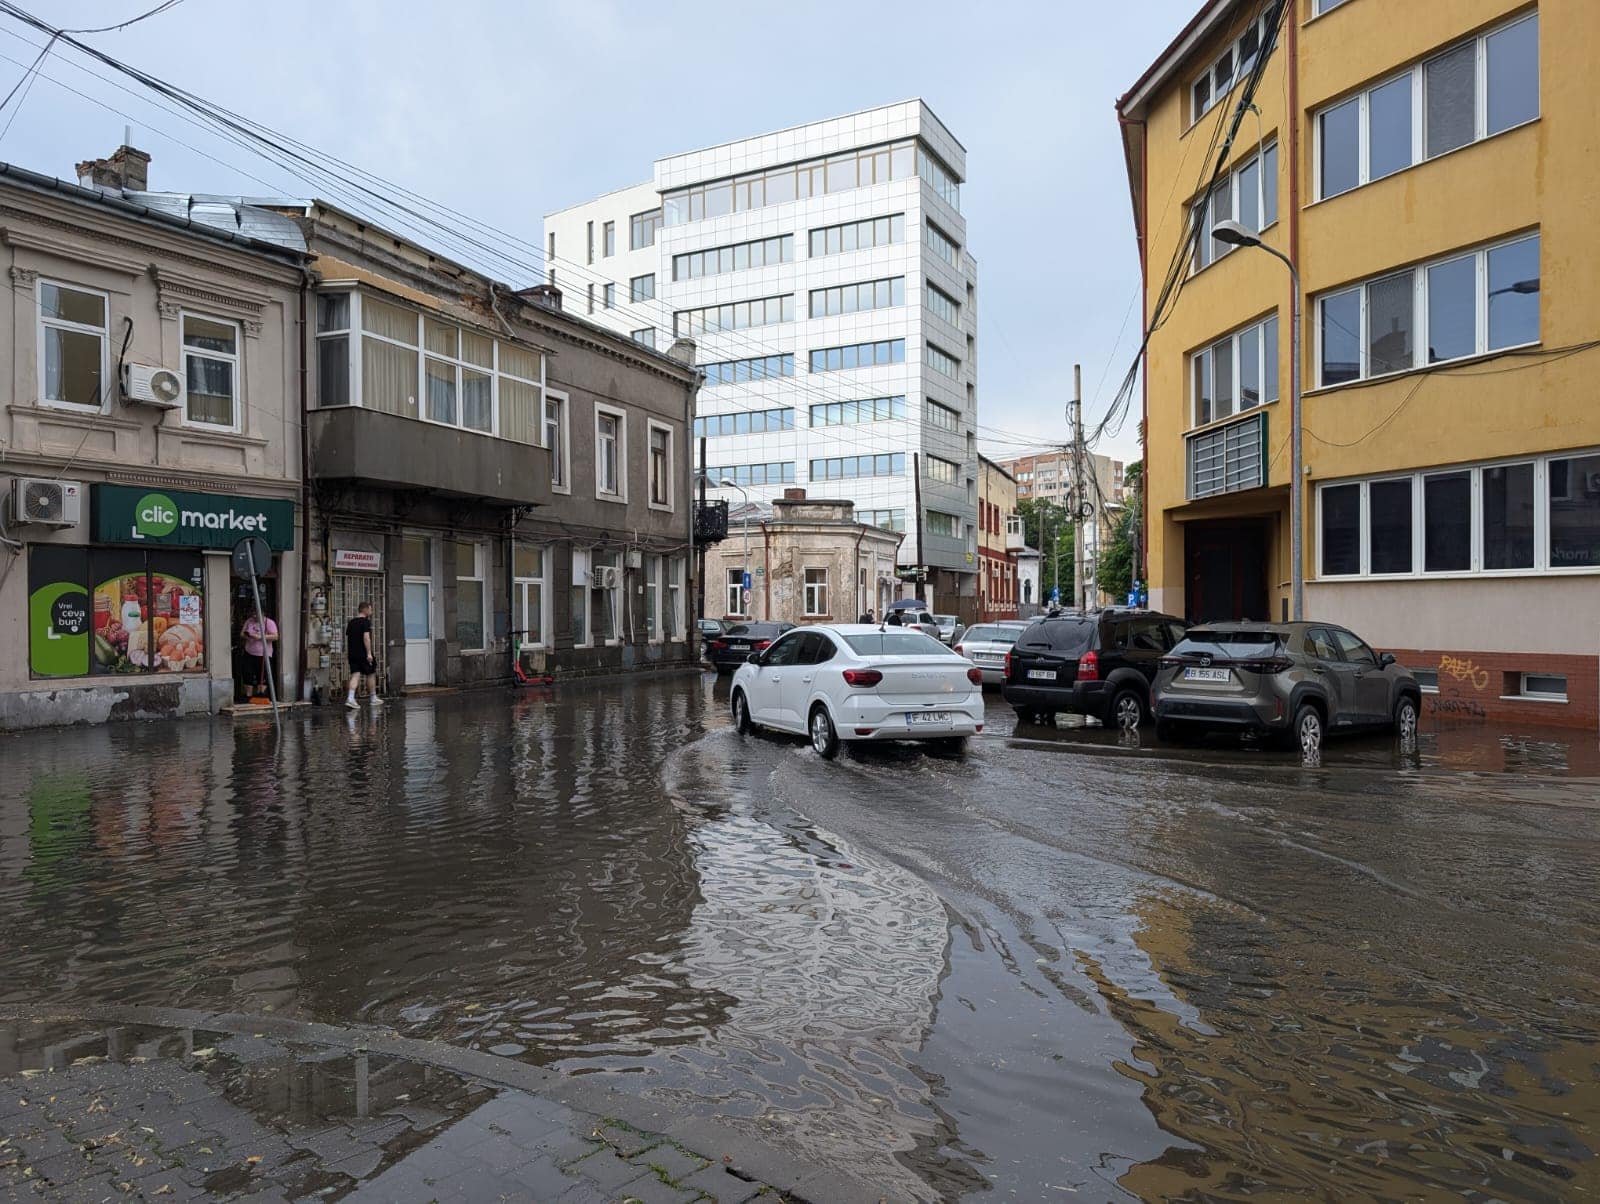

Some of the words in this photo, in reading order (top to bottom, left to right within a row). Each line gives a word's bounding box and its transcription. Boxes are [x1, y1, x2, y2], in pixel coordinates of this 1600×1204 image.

[141, 505, 174, 524] clic
[181, 509, 267, 532] market
[1128, 593, 1135, 604] P
[58, 602, 73, 610] Vrei
[58, 615, 83, 627] bun?
[922, 712, 932, 721] 42
